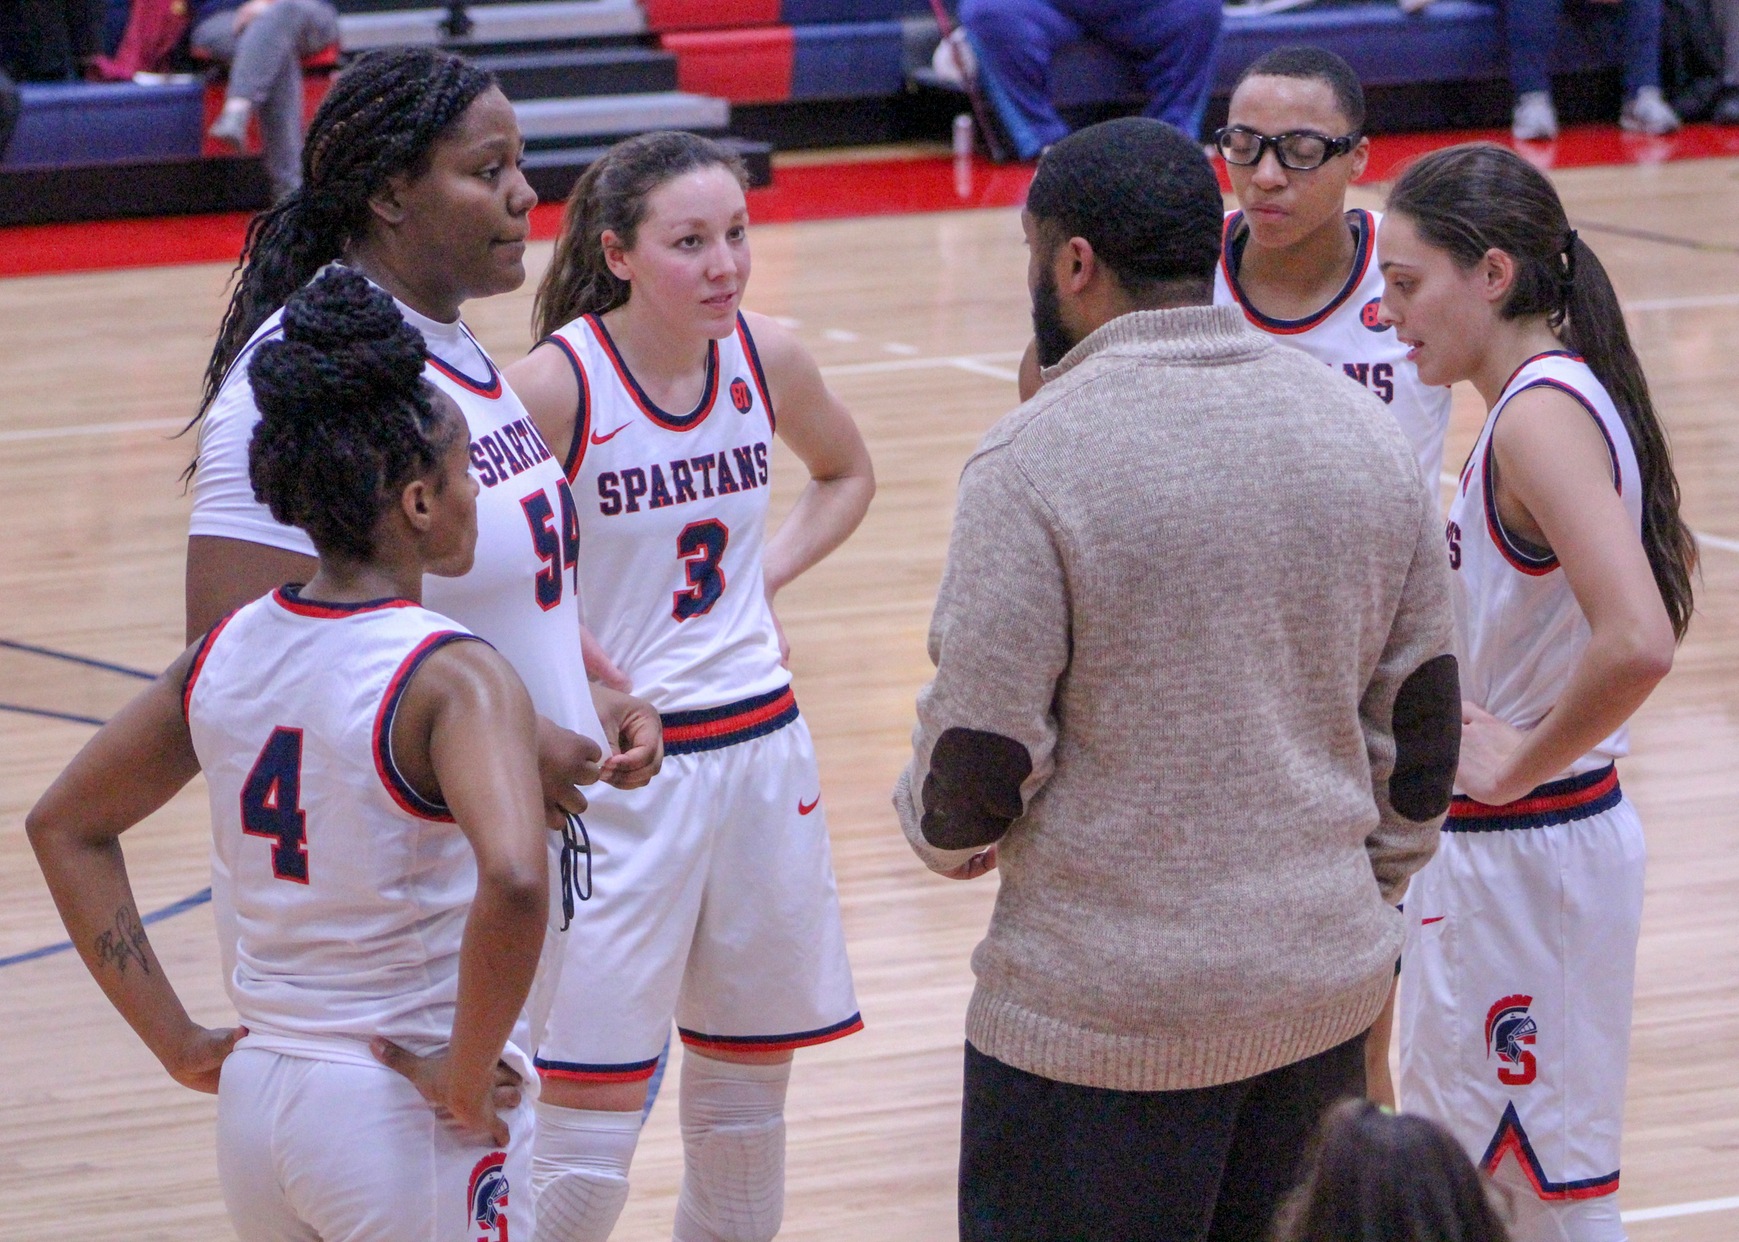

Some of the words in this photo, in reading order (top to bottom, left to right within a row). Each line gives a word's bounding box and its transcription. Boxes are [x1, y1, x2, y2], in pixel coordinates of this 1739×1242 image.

[469, 415, 553, 488] SPARTA
[597, 442, 768, 516] SPARTANS
[519, 477, 580, 612] 54
[671, 517, 729, 623] 3
[239, 725, 310, 885] 4
